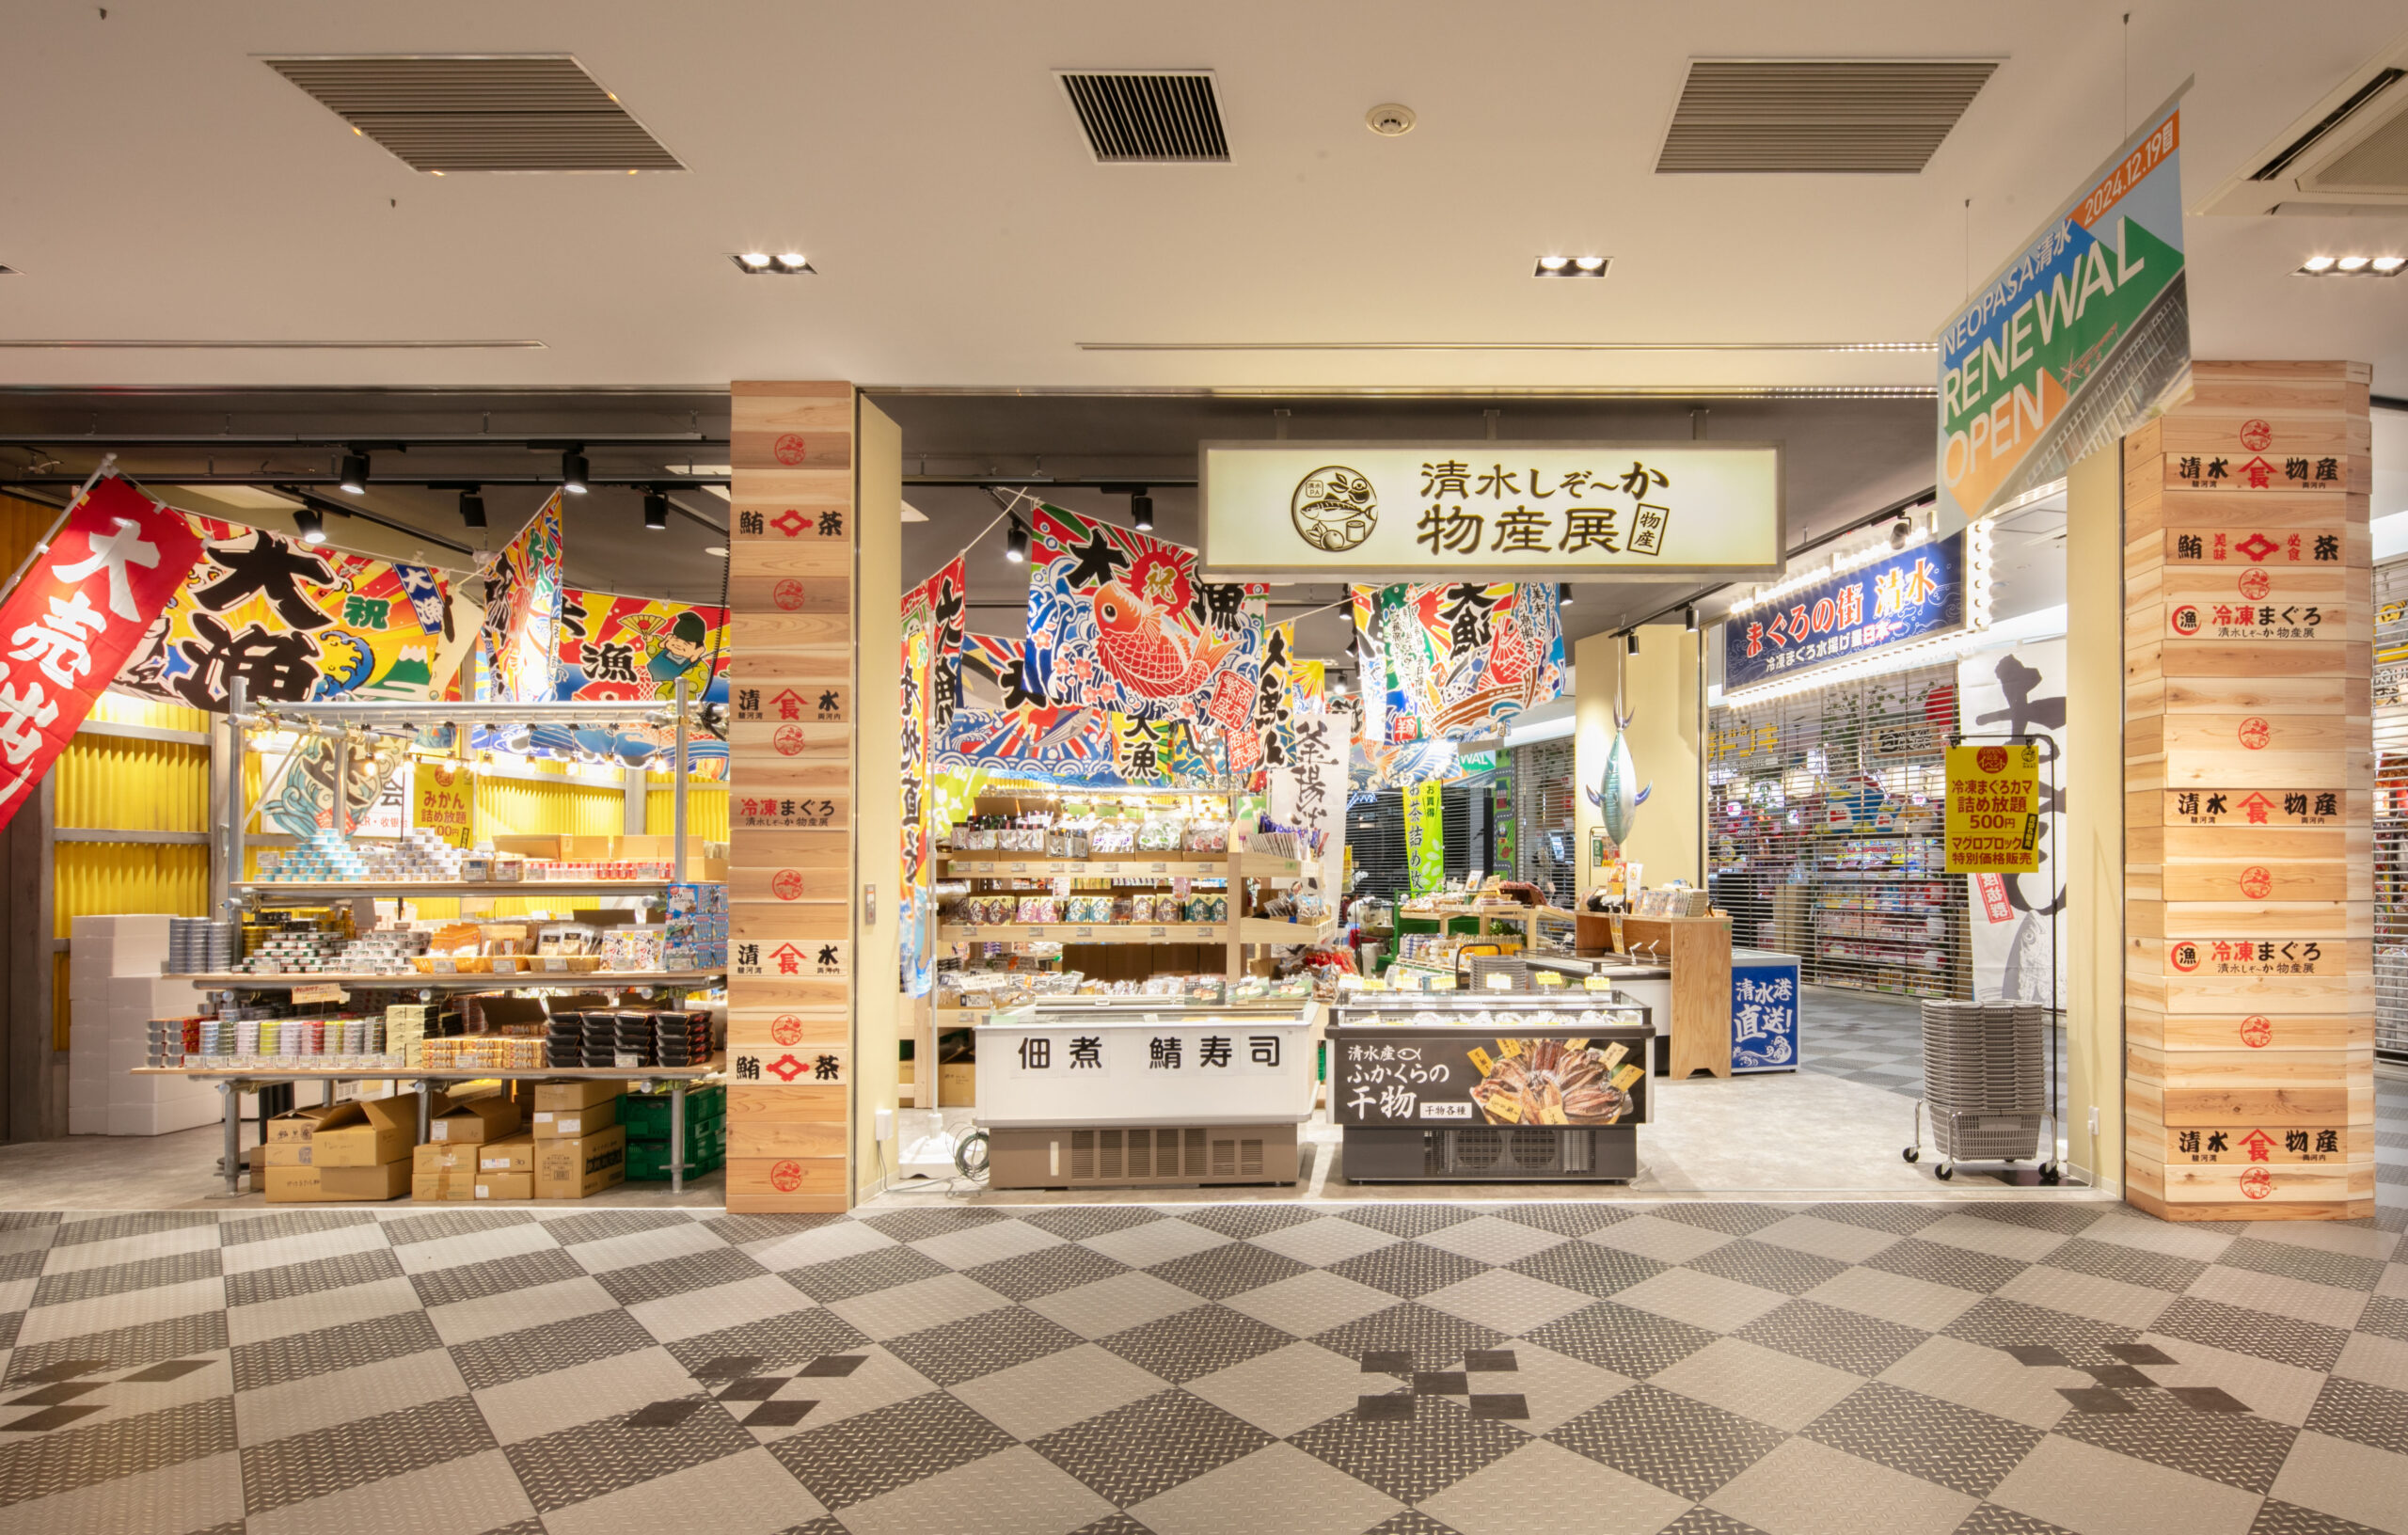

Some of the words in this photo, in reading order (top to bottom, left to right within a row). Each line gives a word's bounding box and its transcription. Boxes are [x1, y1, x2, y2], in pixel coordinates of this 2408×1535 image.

[2083, 131, 2162, 227] 2024.12.19
[1942, 217, 2073, 362] NEOPASA清水
[1942, 214, 2146, 428] RENEWAL
[1941, 366, 2045, 489] OPEN
[2180, 456, 2228, 479] 清水
[2286, 457, 2339, 481] 物産
[740, 511, 764, 535] 鮪
[818, 511, 843, 536] 茶
[1417, 504, 1623, 555] 物産展
[1633, 511, 1661, 548] 物産
[2178, 534, 2203, 560] 鮪
[2212, 533, 2227, 562] 美味
[2287, 533, 2302, 562] 必食
[2314, 535, 2339, 561] 茶
[1144, 562, 1178, 604] 祝
[342, 594, 391, 631] 祝
[1746, 582, 1863, 658] まぐろの街
[1874, 557, 1938, 618] 清水
[2179, 610, 2197, 628] 漁
[2211, 605, 2321, 626] 冷凍まぐろ
[1120, 714, 1162, 780] 大漁
[423, 790, 465, 810] みかん
[1951, 780, 2033, 796] 冷凍まぐろカマ
[421, 810, 467, 824] 詰め放題
[740, 799, 835, 816] 冷凍まぐろ
[1957, 796, 2027, 814] 詰め放題
[2178, 793, 2227, 816] 清水
[2284, 793, 2337, 816] 物産
[1969, 815, 2016, 830] 500円
[1952, 836, 2022, 850] マグロブロック
[1952, 852, 2033, 865] 特別価格販売
[2179, 947, 2196, 964] 漁
[2210, 941, 2322, 962] 冷凍まぐろ
[1735, 977, 1793, 1005] 清水港
[1018, 1036, 1103, 1069] 佃煮
[1149, 1036, 1281, 1069] 鯖寿司
[1347, 1045, 1396, 1063] 清水産
[736, 1055, 761, 1080] 鮪
[815, 1054, 840, 1080] 茶
[1346, 1063, 1450, 1084] ふかくらの
[1346, 1084, 1418, 1121] 干物
[1424, 1104, 1467, 1116] 干物各種
[2179, 1131, 2229, 1153] 清水
[2285, 1130, 2339, 1153] 物産
